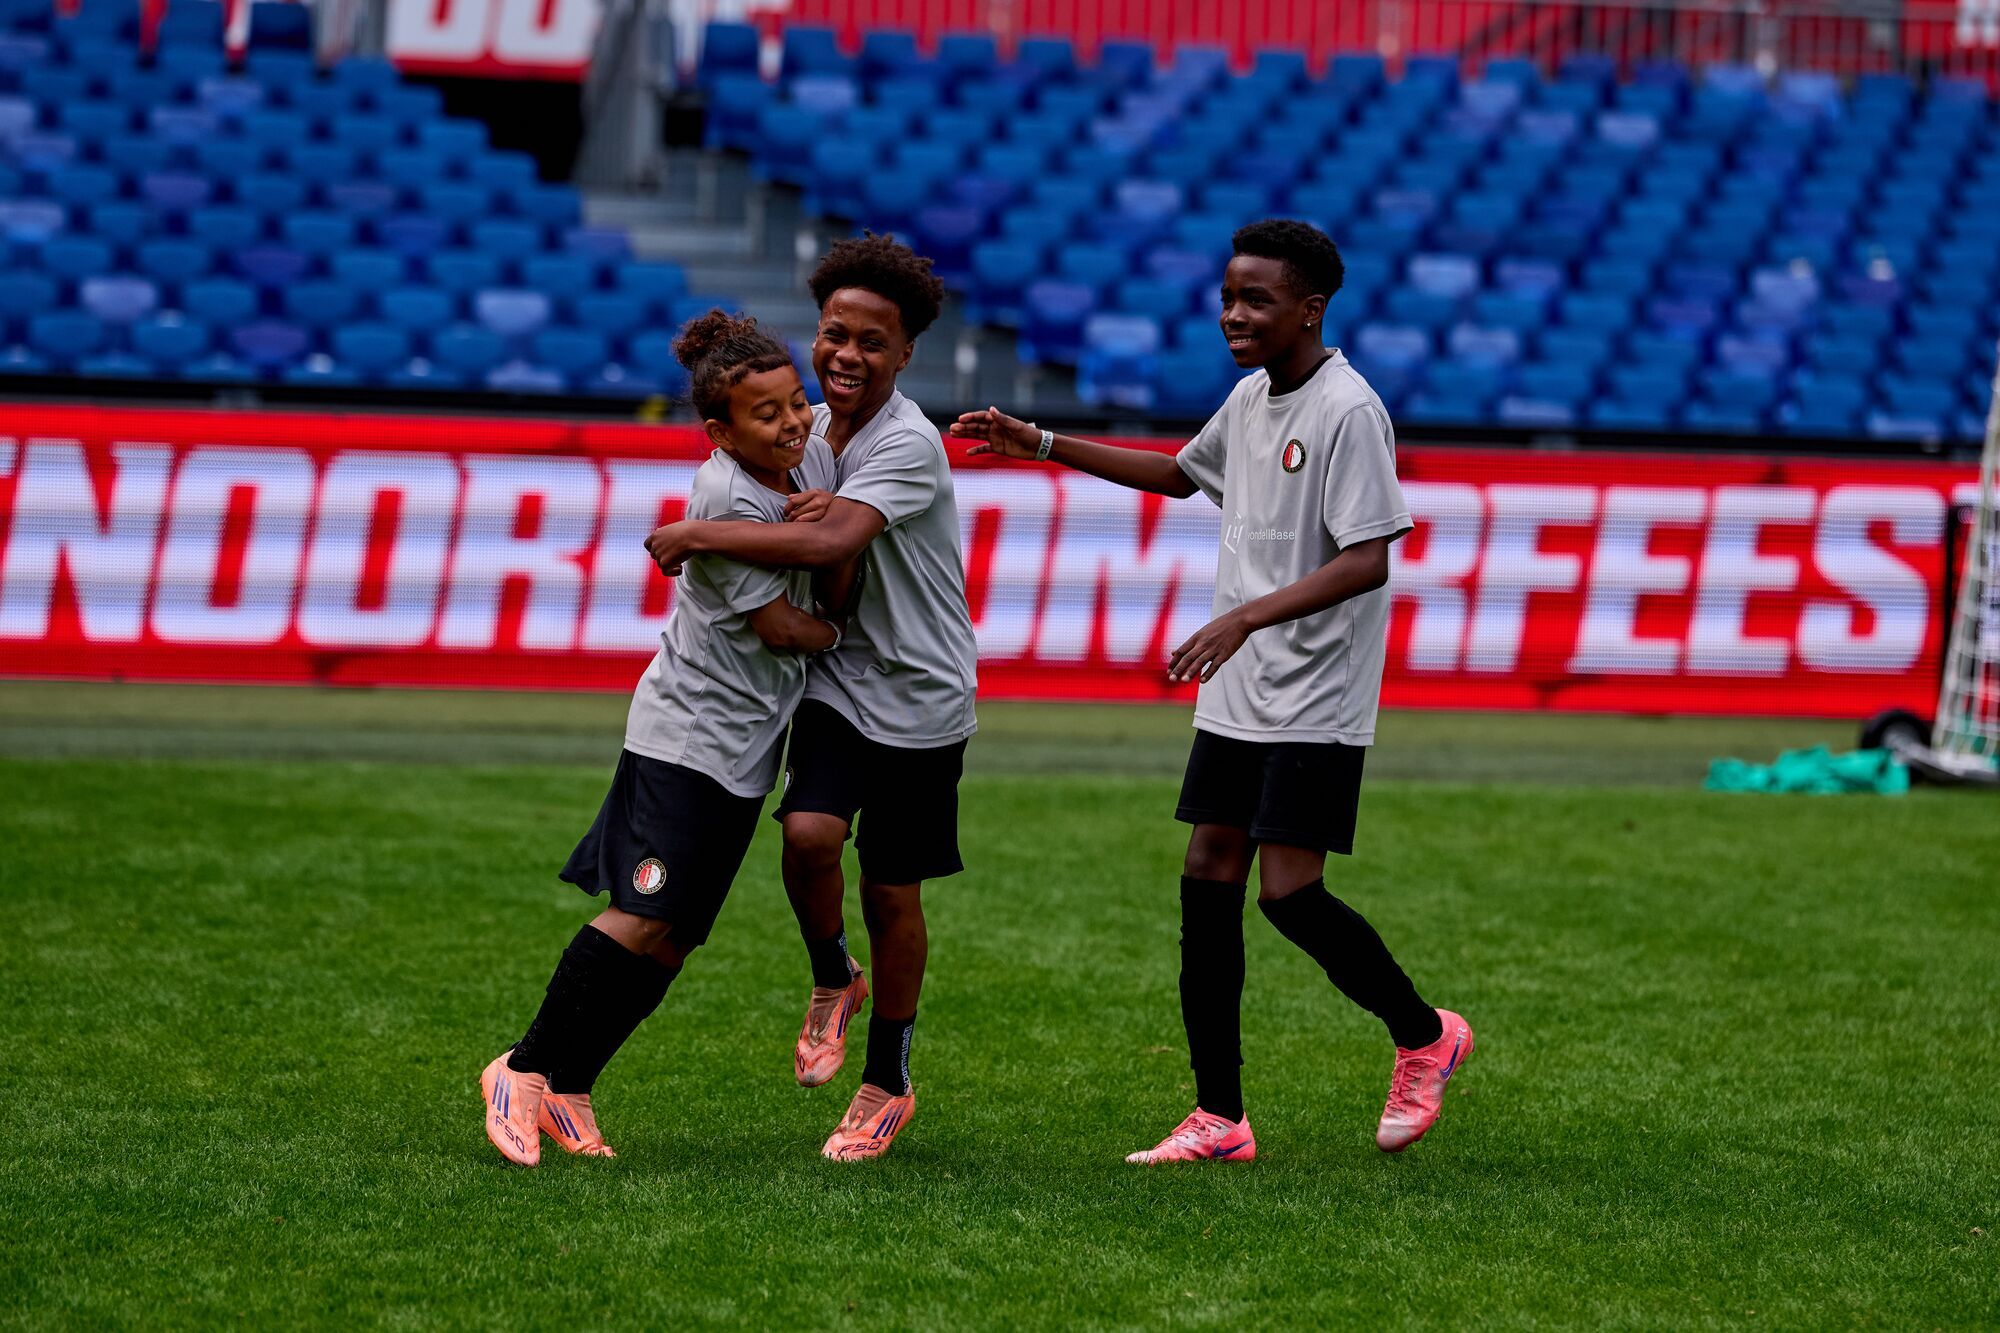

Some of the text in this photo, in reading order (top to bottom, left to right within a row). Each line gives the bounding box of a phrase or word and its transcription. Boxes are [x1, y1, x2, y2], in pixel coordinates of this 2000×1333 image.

[0, 437, 711, 651] NOORD
[495, 1115, 525, 1154] F50
[837, 1140, 882, 1157] F50
